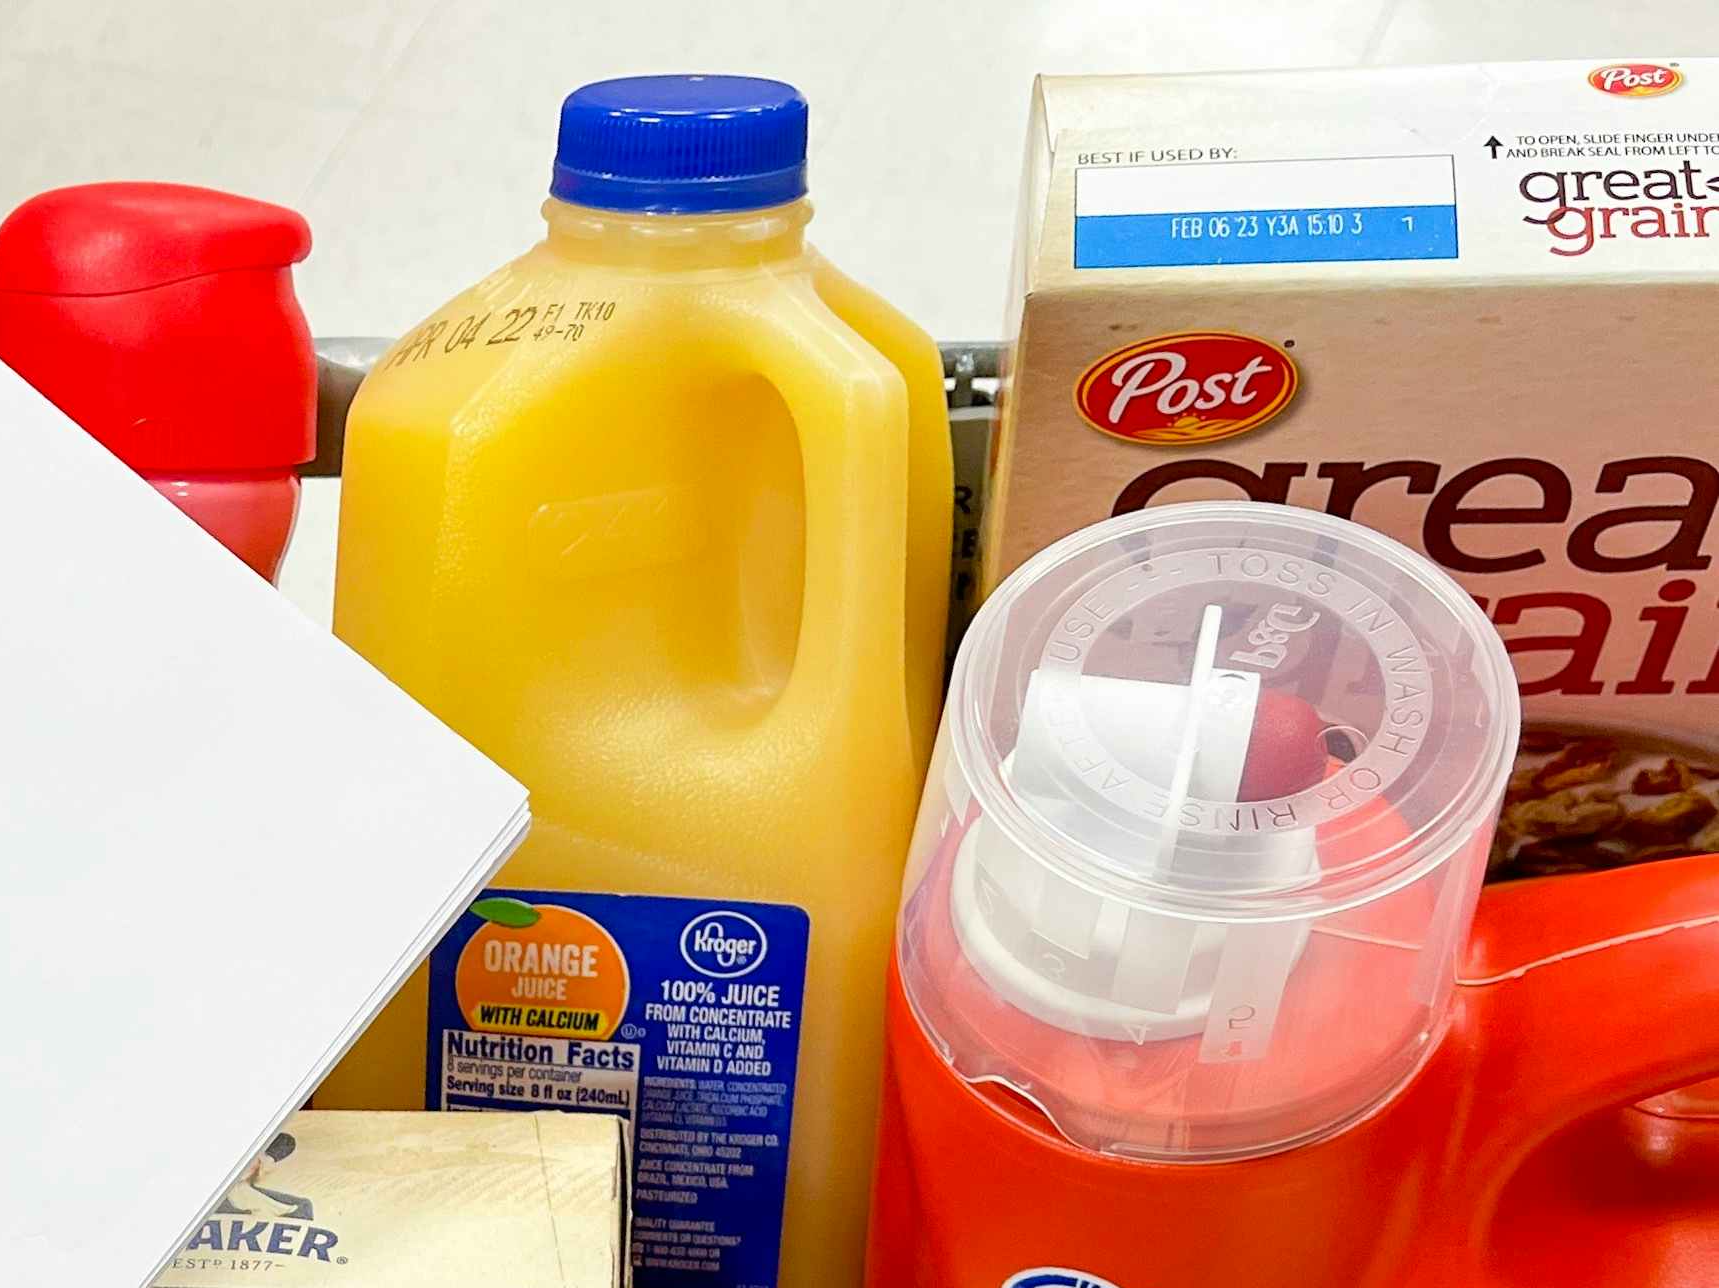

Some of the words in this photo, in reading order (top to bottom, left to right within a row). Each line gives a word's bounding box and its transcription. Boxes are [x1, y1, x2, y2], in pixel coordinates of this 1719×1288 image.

[1600, 67, 1668, 90] Post
[1506, 148, 1539, 159] AND
[1541, 146, 1585, 158] BREAK
[1587, 146, 1622, 158] SEAL
[1625, 145, 1666, 157] FROM
[1668, 145, 1700, 156] LEFT
[1517, 134, 1537, 146] TO
[1538, 134, 1581, 147] OPEN,
[1583, 133, 1622, 145] SLIDE
[1624, 132, 1675, 144] FINGER
[1077, 150, 1123, 165] BEST
[1129, 151, 1146, 164] IF
[1151, 149, 1205, 163] USED
[1208, 146, 1238, 161] BY:
[1519, 160, 1707, 225] great
[1171, 216, 1203, 240] FEB
[1208, 217, 1230, 238] 06
[1266, 214, 1299, 236] Y3A
[1306, 213, 1345, 236] 15:10
[1350, 212, 1363, 235] 3
[444, 313, 491, 353] 04
[486, 306, 537, 346] 22
[1107, 351, 1273, 425] Post
[1207, 552, 1338, 598] TOSS
[1345, 598, 1396, 636] IN
[1048, 599, 1115, 666] USE
[1377, 644, 1424, 758] WASH
[694, 922, 757, 967] Kroger
[484, 940, 600, 978] ORANGE
[511, 976, 568, 1001] JUICE
[661, 979, 716, 1005] 100%
[721, 983, 781, 1008] JUICE
[480, 1004, 523, 1025] WITH
[526, 1008, 600, 1031] CALCIUM
[645, 1003, 687, 1022] FROM
[689, 1006, 792, 1029] CONCENTRATE
[667, 1023, 700, 1040] WITH
[704, 1025, 766, 1046] CALCIUM,
[446, 1031, 554, 1063] Nutrition
[567, 1041, 634, 1069] Facts
[666, 1040, 720, 1058] VITAMIN
[723, 1043, 733, 1058] C
[735, 1044, 764, 1060] AND
[457, 1058, 504, 1078] servings
[507, 1064, 526, 1084] per
[529, 1065, 582, 1083] container
[656, 1055, 714, 1073] VITAMIN
[713, 1059, 723, 1074] D
[726, 1060, 772, 1077] ADDED
[446, 1075, 495, 1097] Serving
[499, 1081, 525, 1097] size
[531, 1085, 540, 1098] 8
[544, 1085, 553, 1099] fl
[556, 1089, 572, 1101] oz
[576, 1086, 630, 1107] (240mL)
[640, 1128, 696, 1143] DISTRIBUTED
[697, 1131, 709, 1144] BY
[711, 1132, 727, 1145] THE
[729, 1133, 764, 1147] KROGER
[638, 1159, 663, 1172] JUICE
[664, 1160, 726, 1175] CONCENTRATE
[727, 1164, 755, 1177] FROM
[185, 1220, 339, 1263] AKER
